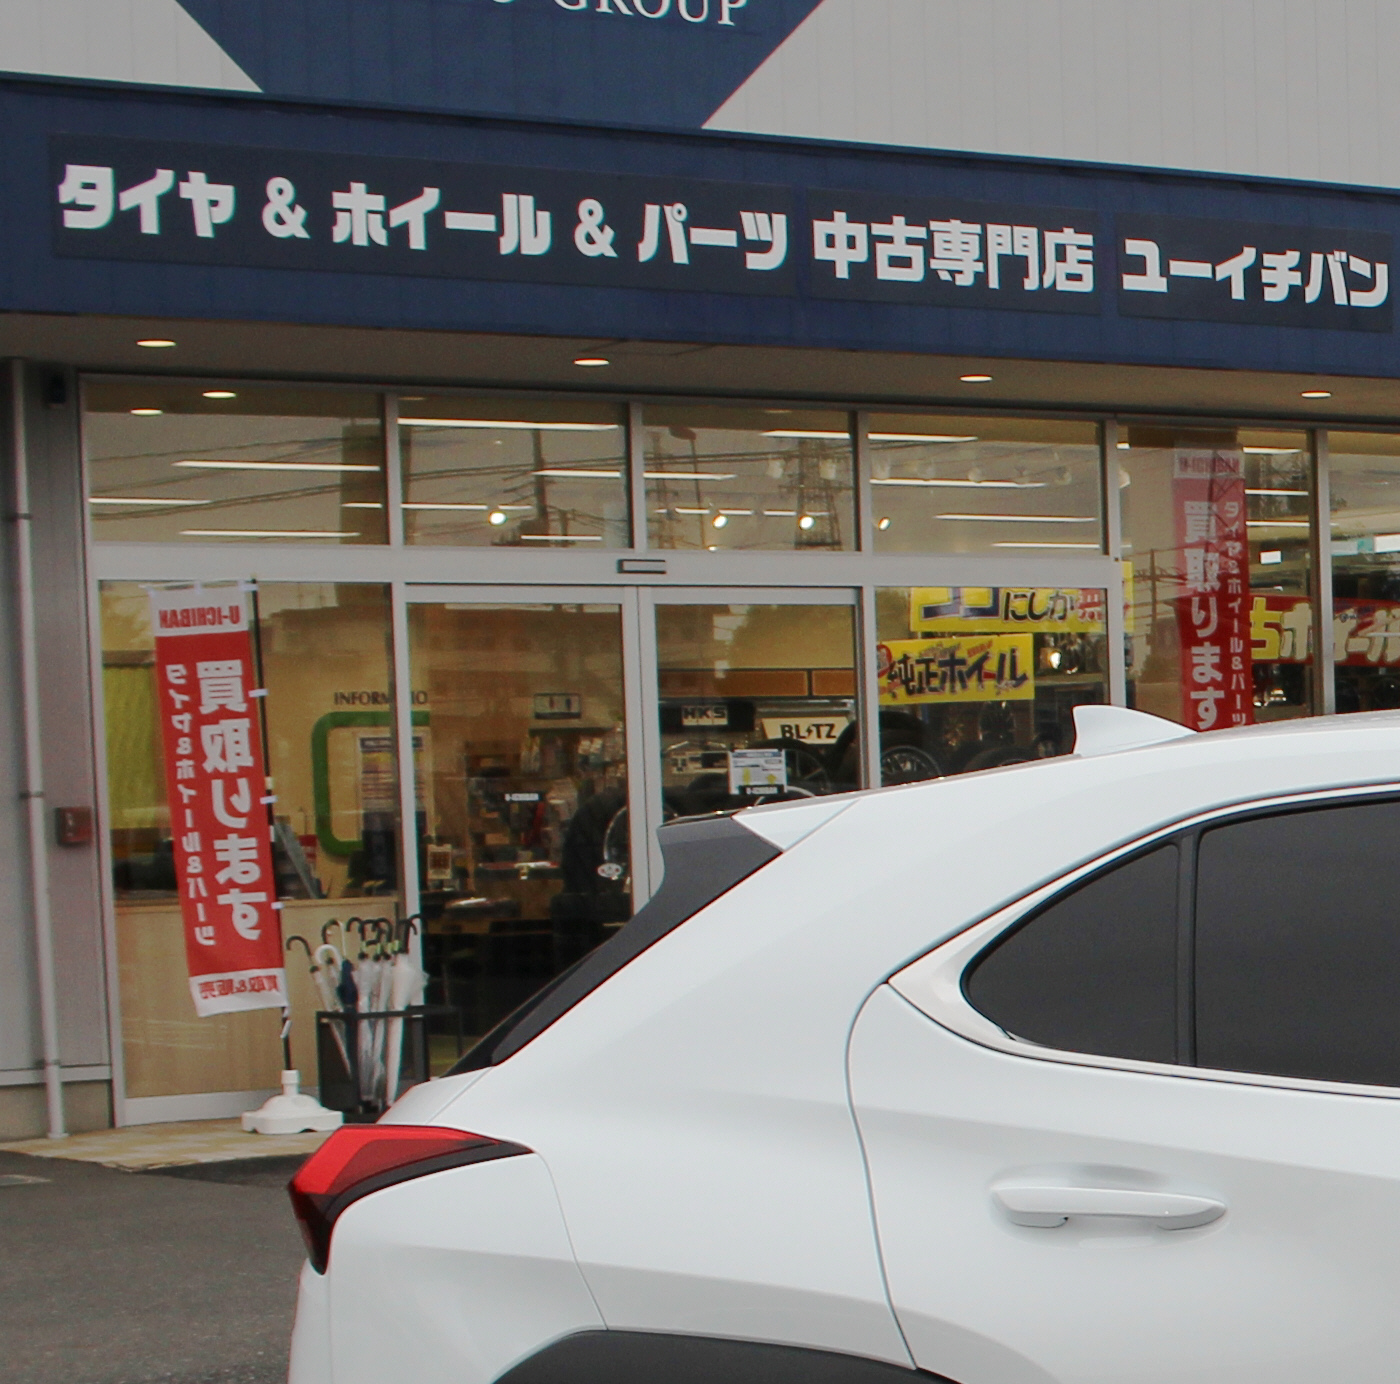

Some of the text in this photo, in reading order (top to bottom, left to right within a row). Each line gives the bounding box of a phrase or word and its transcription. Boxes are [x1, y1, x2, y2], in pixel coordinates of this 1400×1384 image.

[58, 163, 1390, 309] タイヤ & ホイール & パーツ 中古専門店 ユーイチバン
